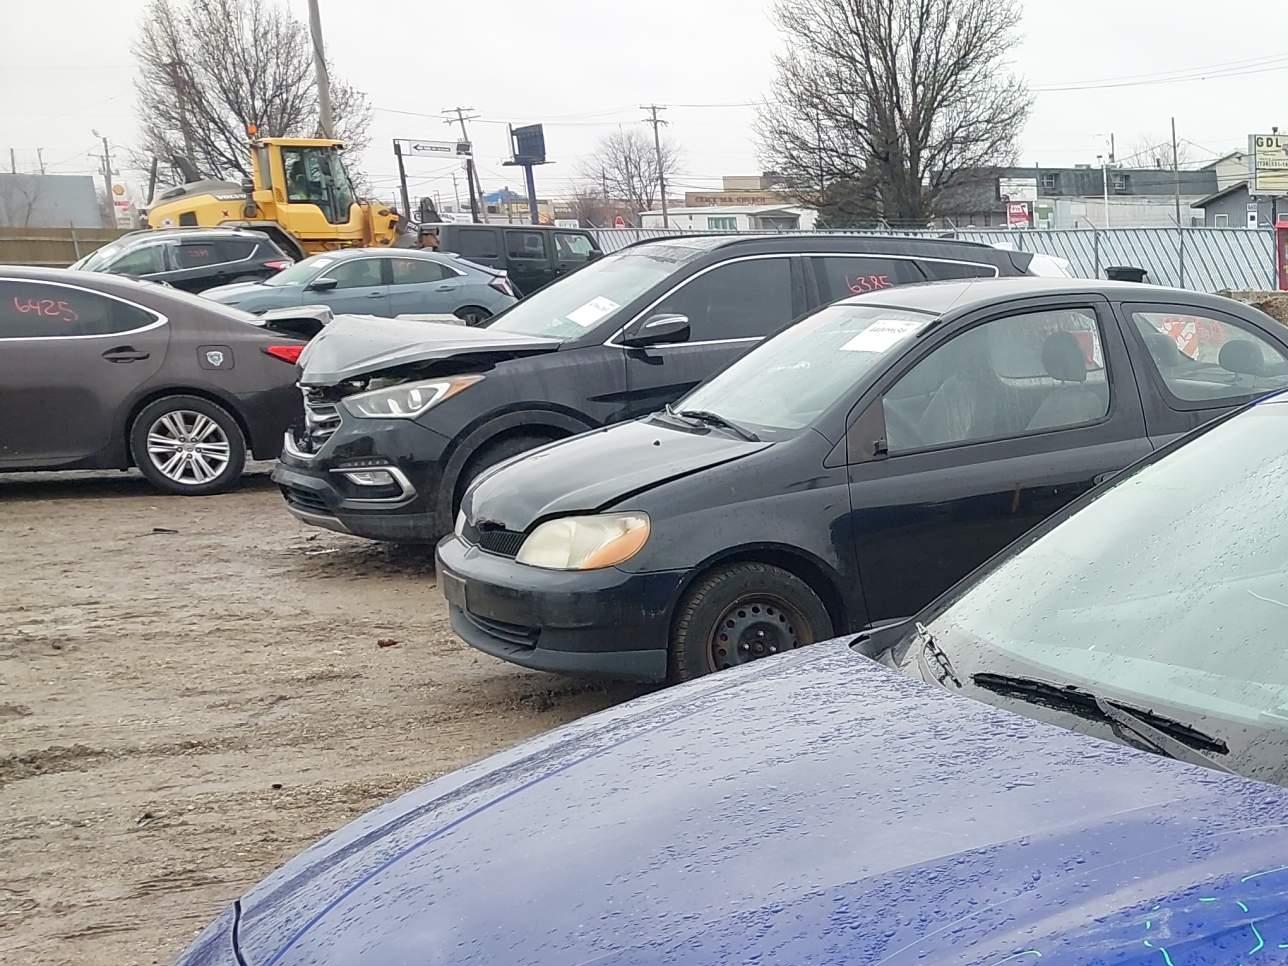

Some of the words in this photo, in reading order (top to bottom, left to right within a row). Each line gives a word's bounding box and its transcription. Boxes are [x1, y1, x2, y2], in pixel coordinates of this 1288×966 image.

[1256, 137, 1281, 148] GDL
[844, 274, 894, 294] 6385
[14, 296, 79, 322] 6425
